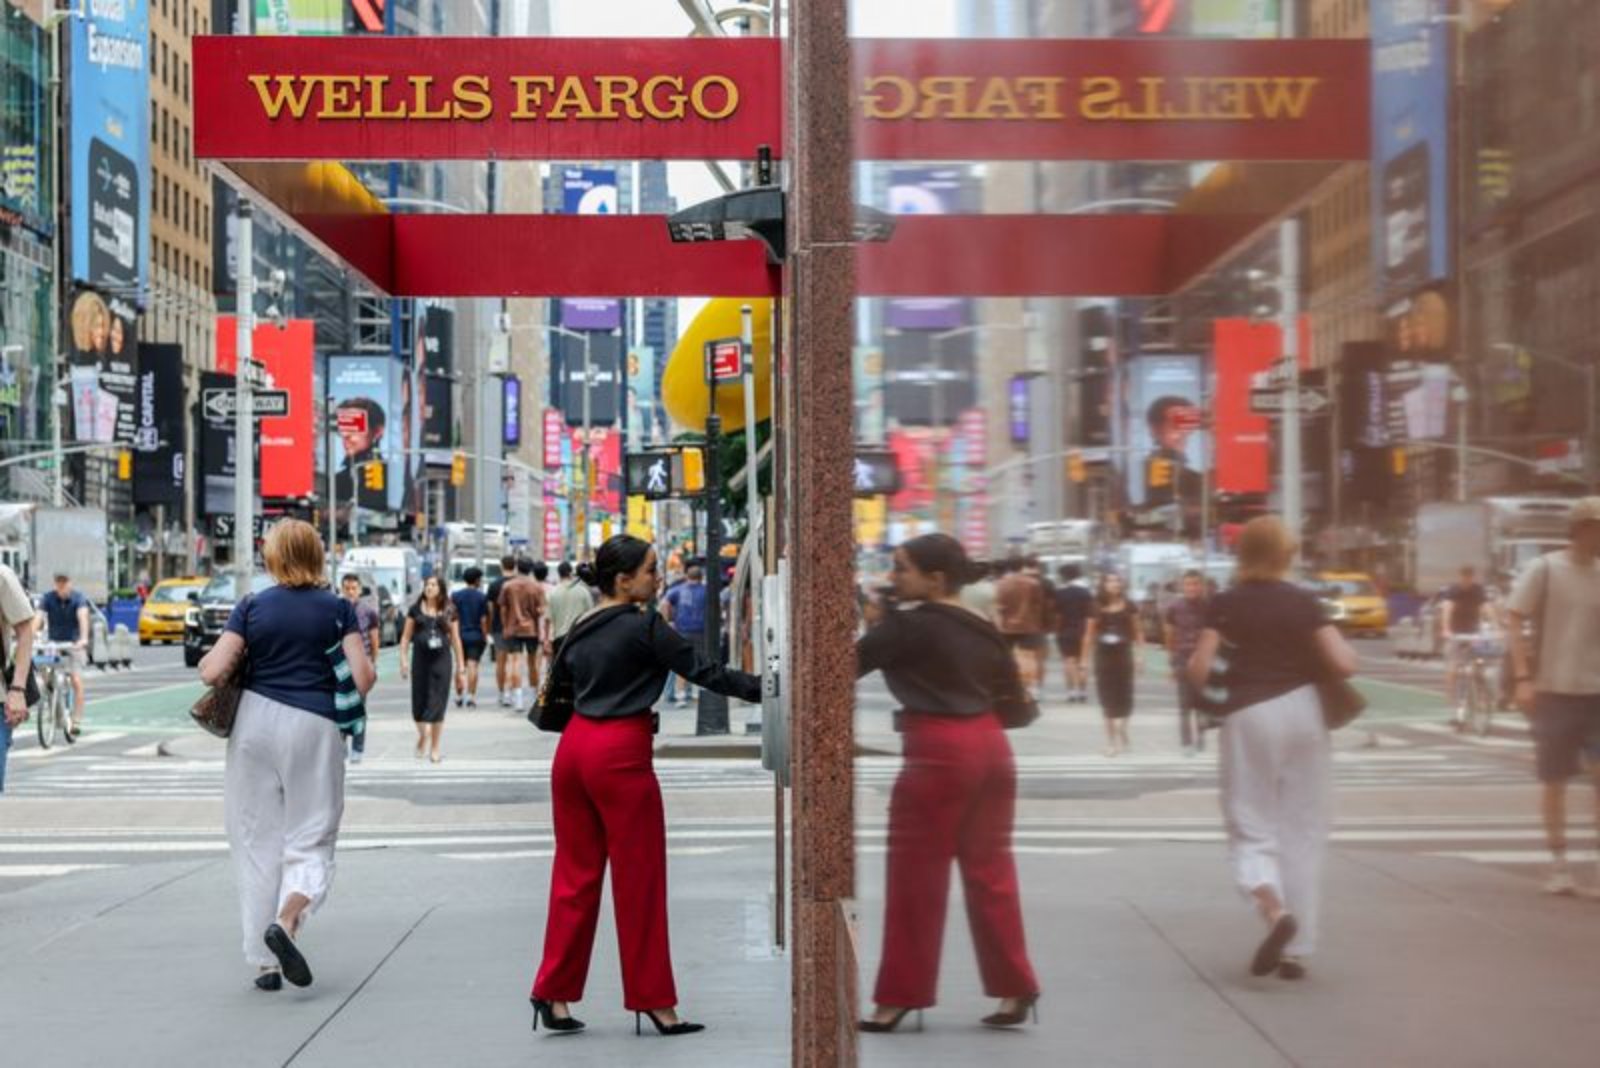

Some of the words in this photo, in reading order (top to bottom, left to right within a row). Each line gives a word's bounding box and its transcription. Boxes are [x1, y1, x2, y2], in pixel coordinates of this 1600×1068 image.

[248, 75, 492, 120] WELLS
[510, 75, 740, 120] FARGO
[141, 371, 154, 427] CAPITAL
[216, 397, 236, 411] ON
[255, 397, 283, 410] WAY
